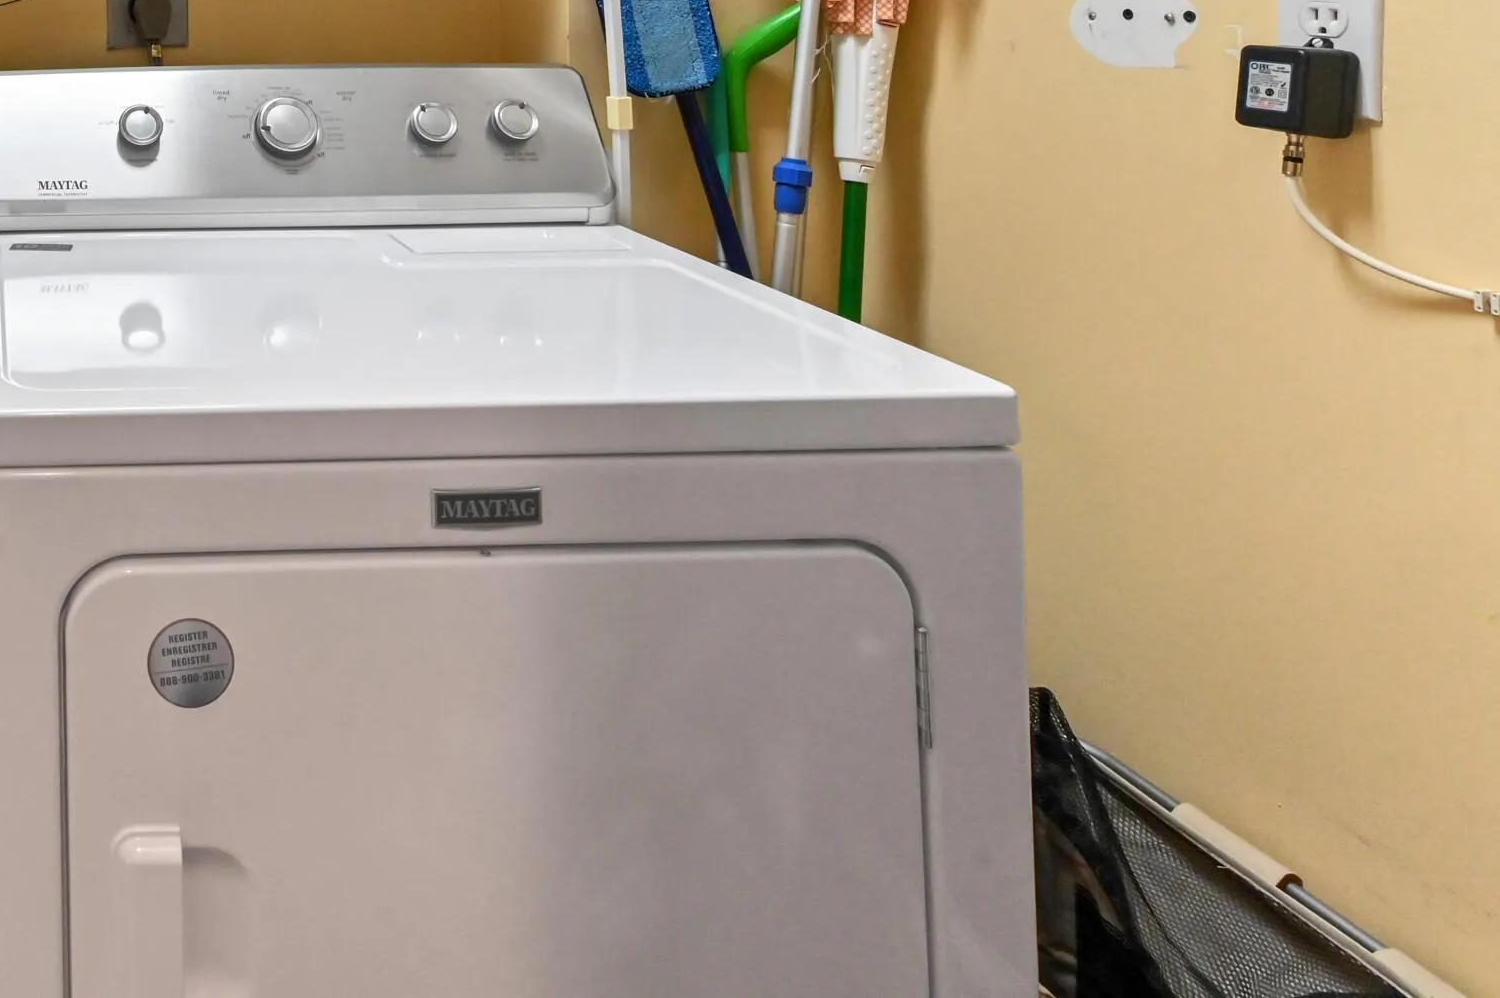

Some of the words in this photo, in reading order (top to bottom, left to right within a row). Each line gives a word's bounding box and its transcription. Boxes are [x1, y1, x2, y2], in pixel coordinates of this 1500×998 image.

[38, 180, 88, 190] MAYTAG
[440, 498, 536, 519] MAYTAG
[168, 630, 209, 644] REGISTER
[161, 642, 218, 657] ENREGISTRER
[171, 654, 211, 668] REGISTRE
